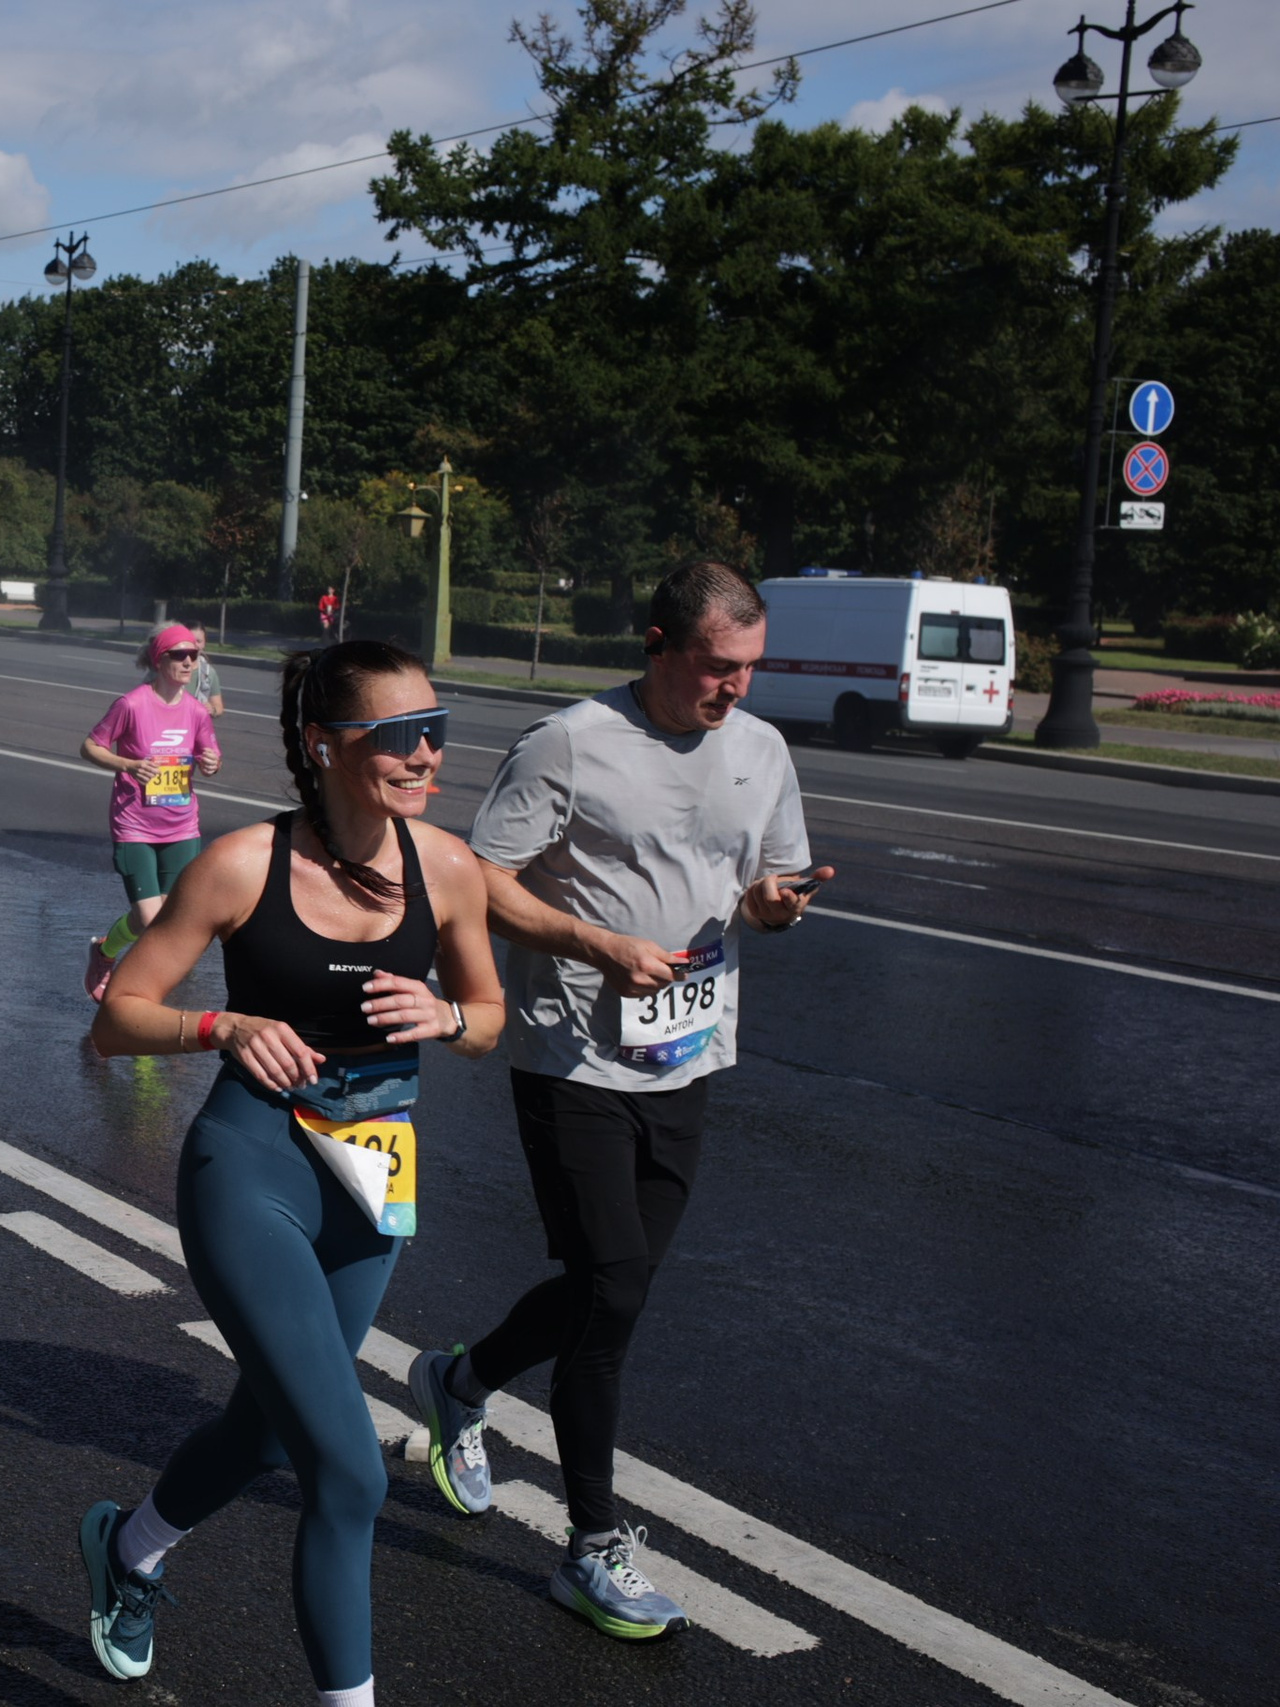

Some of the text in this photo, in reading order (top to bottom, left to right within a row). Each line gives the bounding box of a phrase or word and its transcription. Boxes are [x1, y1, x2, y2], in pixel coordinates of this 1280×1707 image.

[328, 963, 374, 973] EAZYWAY
[638, 976, 716, 1025] 3198
[664, 1018, 695, 1036] АНТОН
